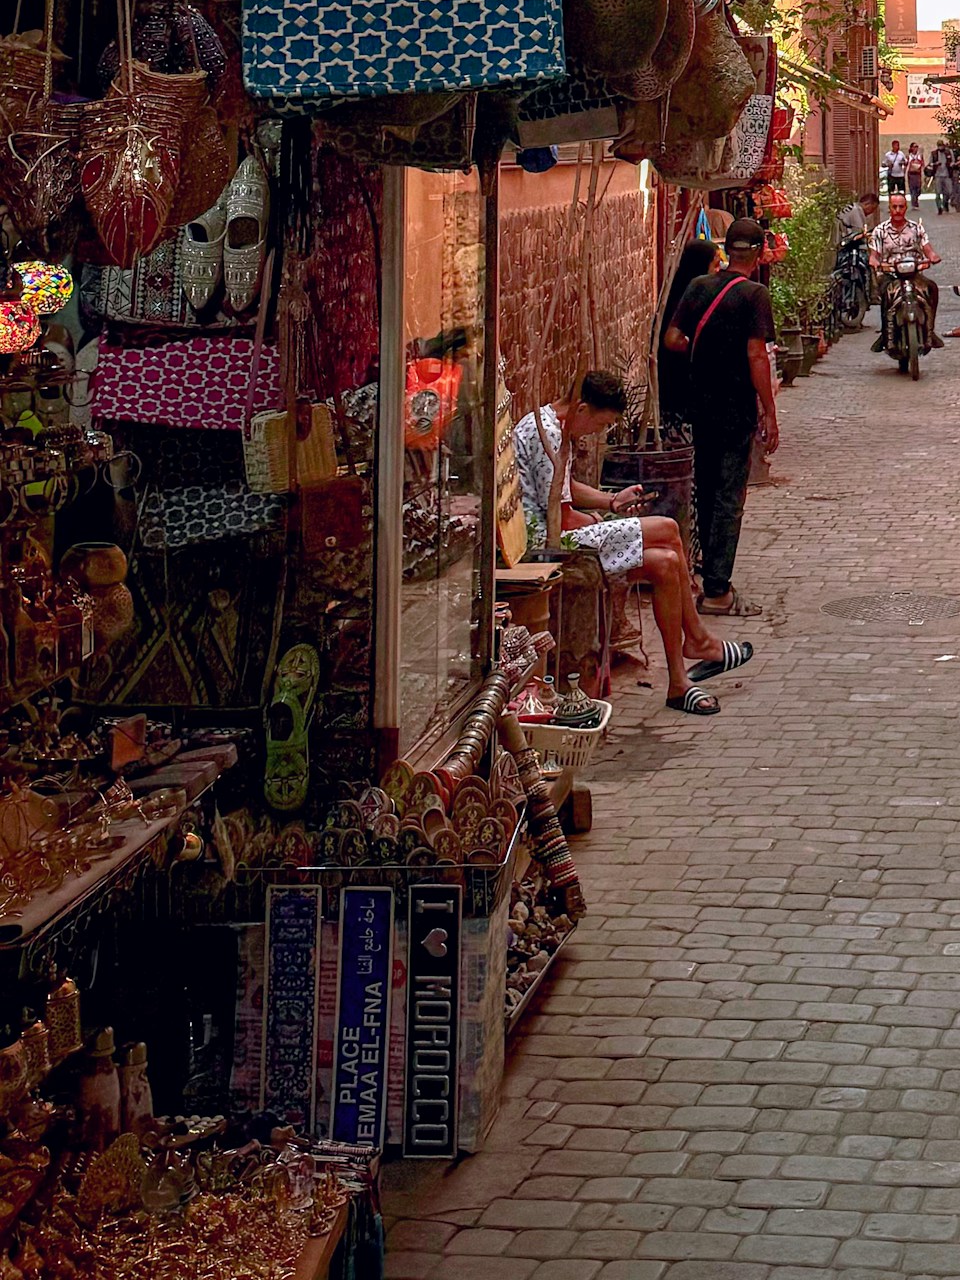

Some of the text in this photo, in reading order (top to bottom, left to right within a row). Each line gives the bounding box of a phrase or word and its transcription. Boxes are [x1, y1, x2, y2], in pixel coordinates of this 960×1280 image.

[355, 898, 381, 976] ساحة جامع الفنا
[361, 981, 384, 1065] EL-FNA
[411, 899, 454, 1146] I MOROCCO
[339, 1025, 361, 1105] PLACE
